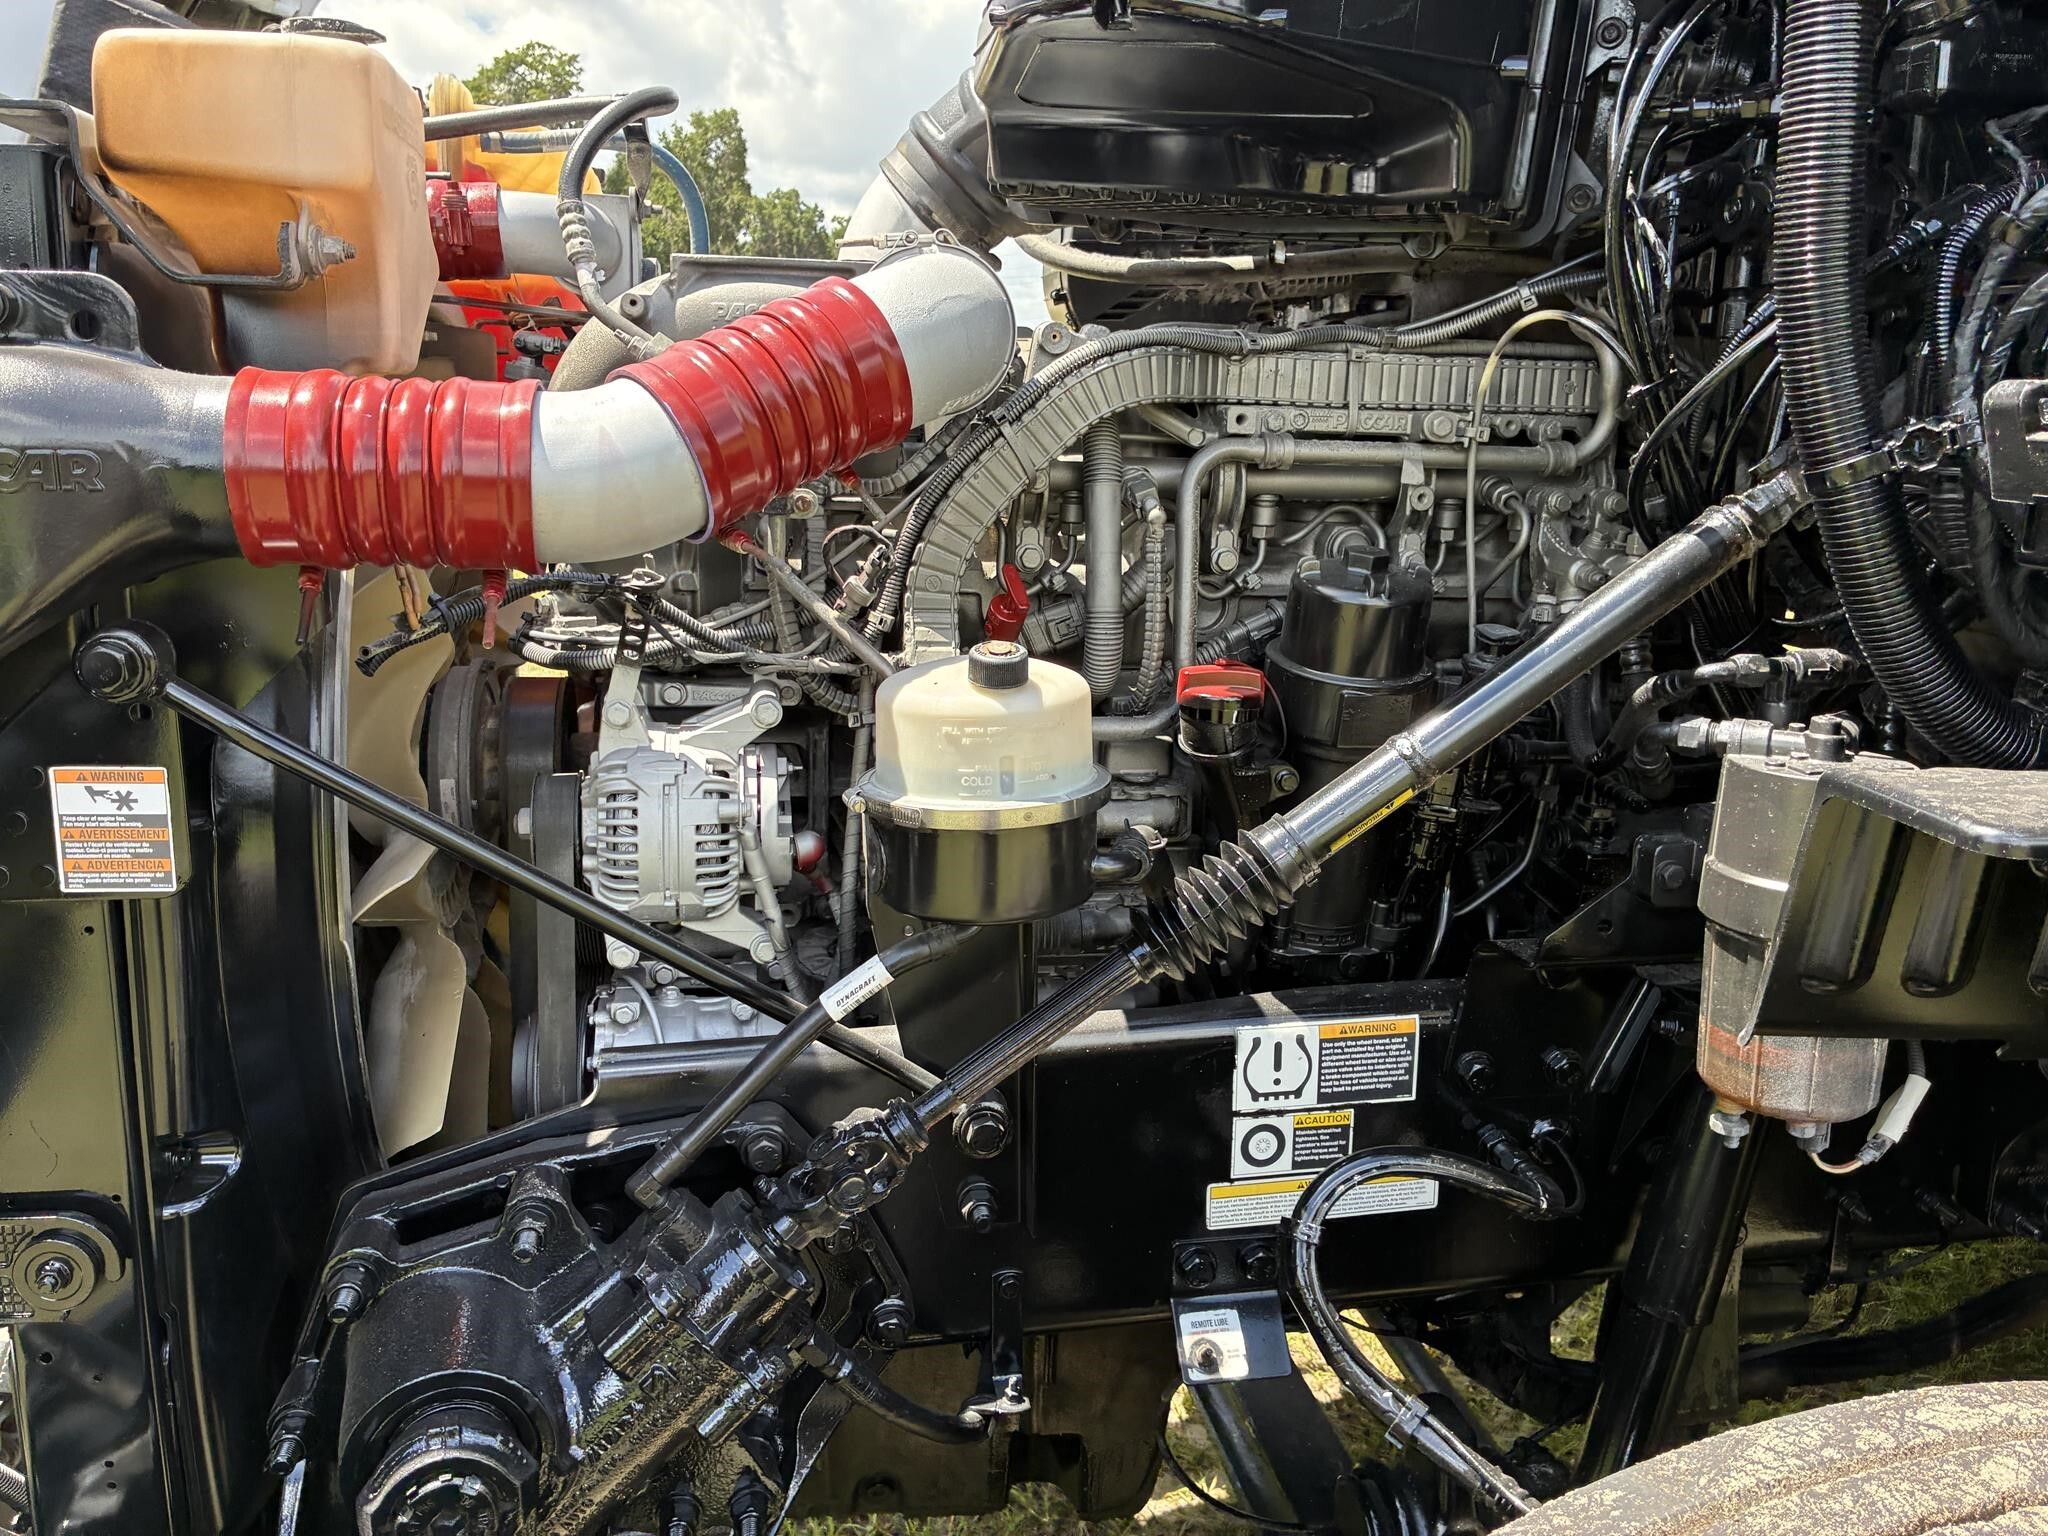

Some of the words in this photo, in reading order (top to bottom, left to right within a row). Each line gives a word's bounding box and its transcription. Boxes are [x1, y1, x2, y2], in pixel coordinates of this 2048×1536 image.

[90, 772, 144, 782] WARNING
[960, 776, 993, 786] COLD
[79, 829, 167, 839] AVERTISSEMENT
[87, 860, 165, 870] ADVERTENCIA
[836, 975, 876, 1008] DYNACRAFT
[1348, 1022, 1397, 1034] WARNING
[1385, 1042, 1405, 1050] original
[1322, 1054, 1350, 1062] equipment
[1304, 1114, 1350, 1125] CAUTION
[1190, 1319, 1213, 1329] REMOTE
[1214, 1317, 1229, 1327] LUBE
